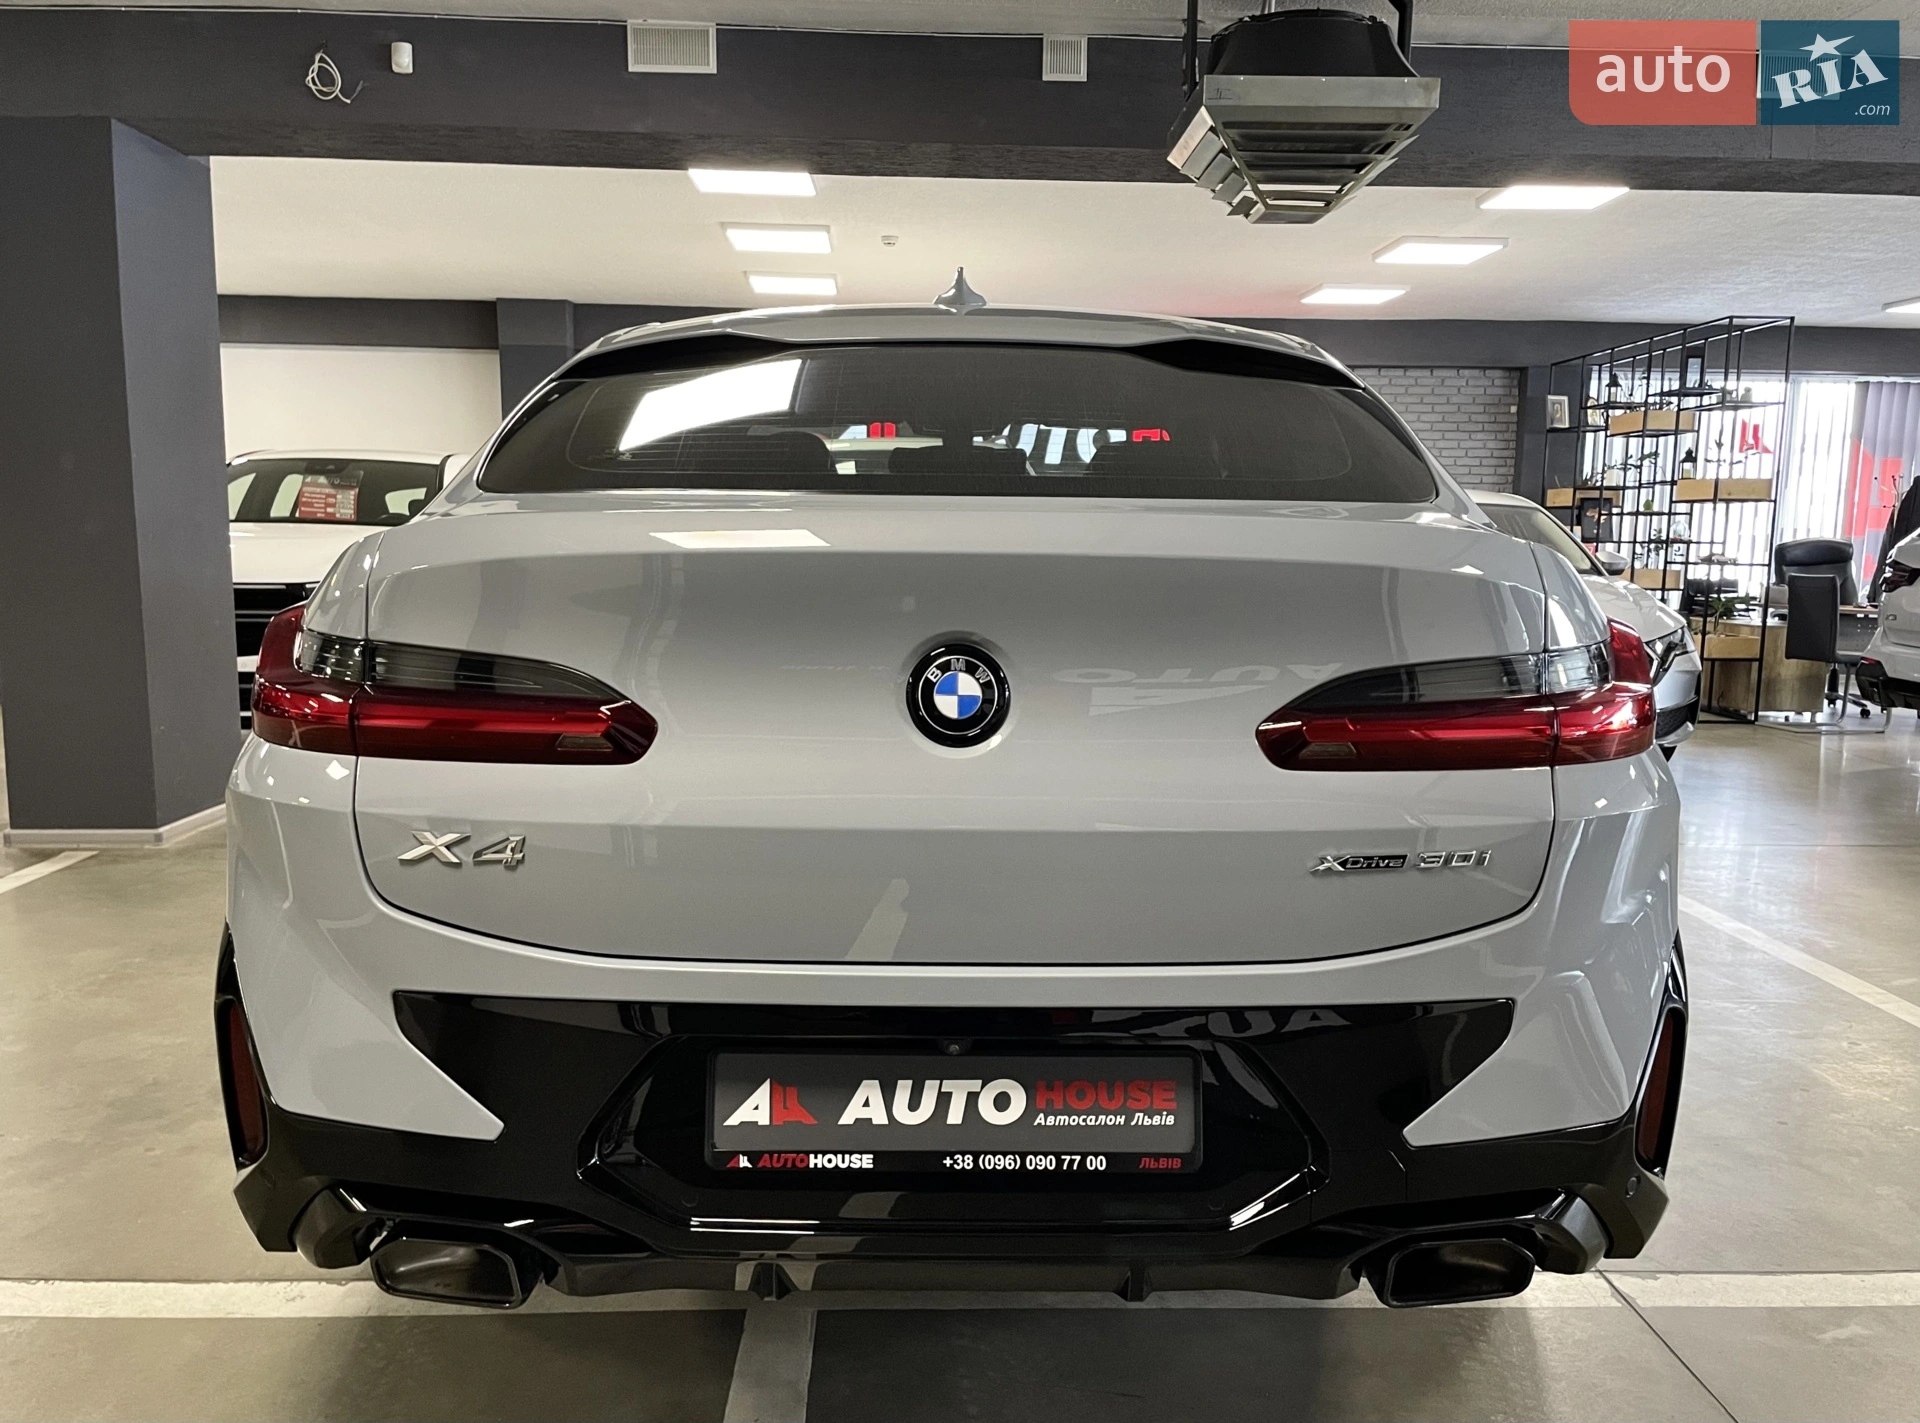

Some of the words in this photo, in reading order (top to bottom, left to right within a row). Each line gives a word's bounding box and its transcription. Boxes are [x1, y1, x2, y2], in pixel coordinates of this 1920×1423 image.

[926, 658, 991, 683] BMW
[397, 830, 526, 868] X4
[1416, 849, 1493, 868] 30i
[837, 1079, 1027, 1125] AUTO
[1035, 1080, 1177, 1110] HOUSE
[1034, 1112, 1126, 1126] Автосалон
[1130, 1111, 1175, 1126] Львів
[943, 1154, 974, 1170] +38
[979, 1154, 1021, 1170] (096)
[1026, 1154, 1056, 1170] 090
[1061, 1155, 1082, 1170] 77
[1086, 1155, 1107, 1170] 00
